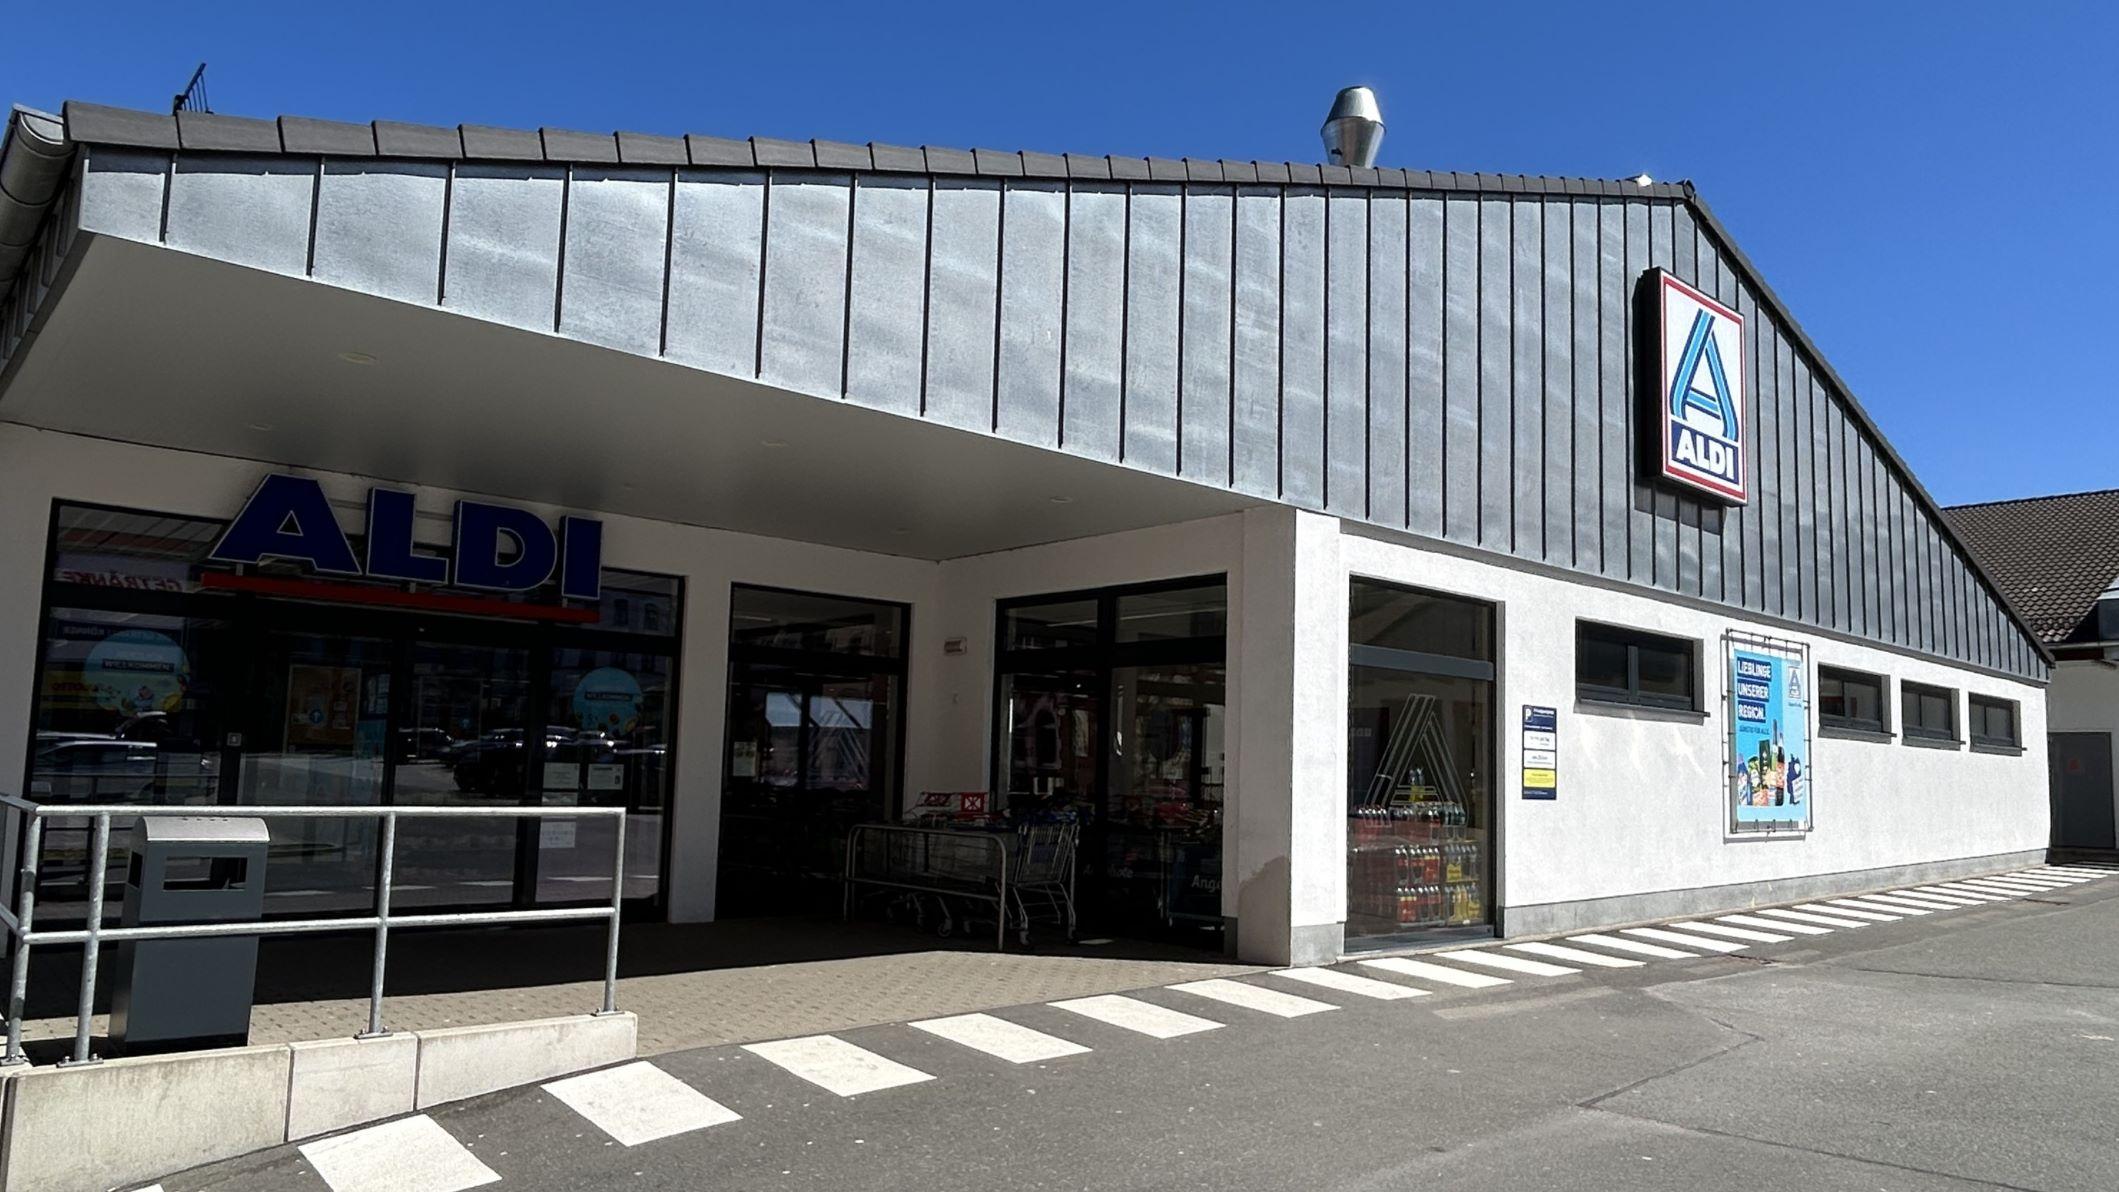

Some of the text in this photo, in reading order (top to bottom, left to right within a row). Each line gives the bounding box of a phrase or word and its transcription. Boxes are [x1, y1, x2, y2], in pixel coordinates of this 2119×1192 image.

[1676, 429, 1735, 479] ALDI
[208, 472, 603, 602] ALDI
[1737, 660, 1772, 679] LIEBLINGE
[1737, 682, 1770, 700] UNSERER
